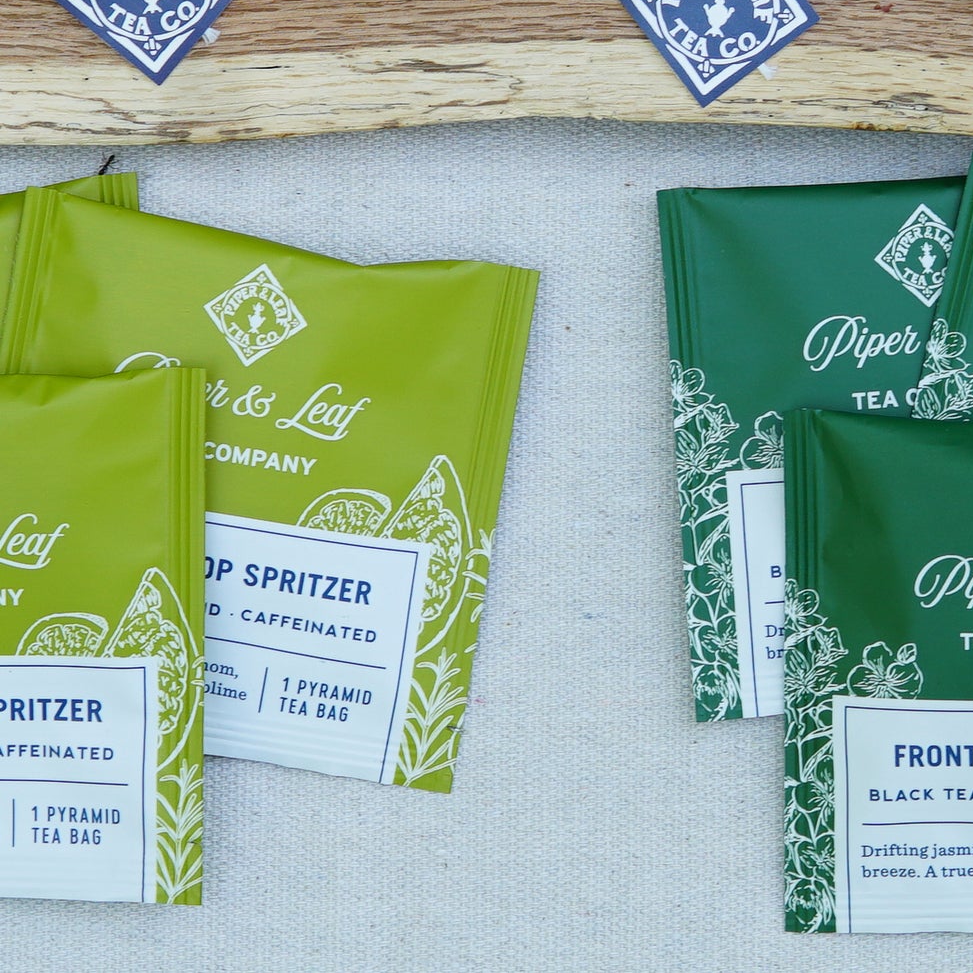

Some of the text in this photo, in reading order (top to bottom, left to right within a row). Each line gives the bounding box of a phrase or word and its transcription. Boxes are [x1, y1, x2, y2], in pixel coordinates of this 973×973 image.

[107, 0, 200, 36] TEA CO.
[669, 17, 761, 59] TEA CO.
[894, 227, 924, 263] PIPER
[902, 267, 928, 286] TEA
[223, 285, 258, 317] PIPER
[258, 287, 269, 301] &
[228, 321, 250, 346] TEA
[803, 314, 922, 373] Piper
[232, 384, 277, 418] &
[275, 383, 372, 441] Leaf
[851, 390, 900, 410] TEA
[204, 441, 318, 476] COMPANY
[243, 563, 373, 605] SPRITZER
[240, 609, 377, 643] CAFFEINATED
[282, 677, 373, 706] 1 PYRAMID
[279, 696, 350, 722] TEA BAG
[869, 787, 934, 803] BLACK
[31, 806, 121, 825] 1 PYRAMID
[32, 827, 102, 845] TEA BAG
[861, 843, 929, 860] Drifting
[861, 865, 921, 879] breeze.
[924, 864, 938, 878] A
